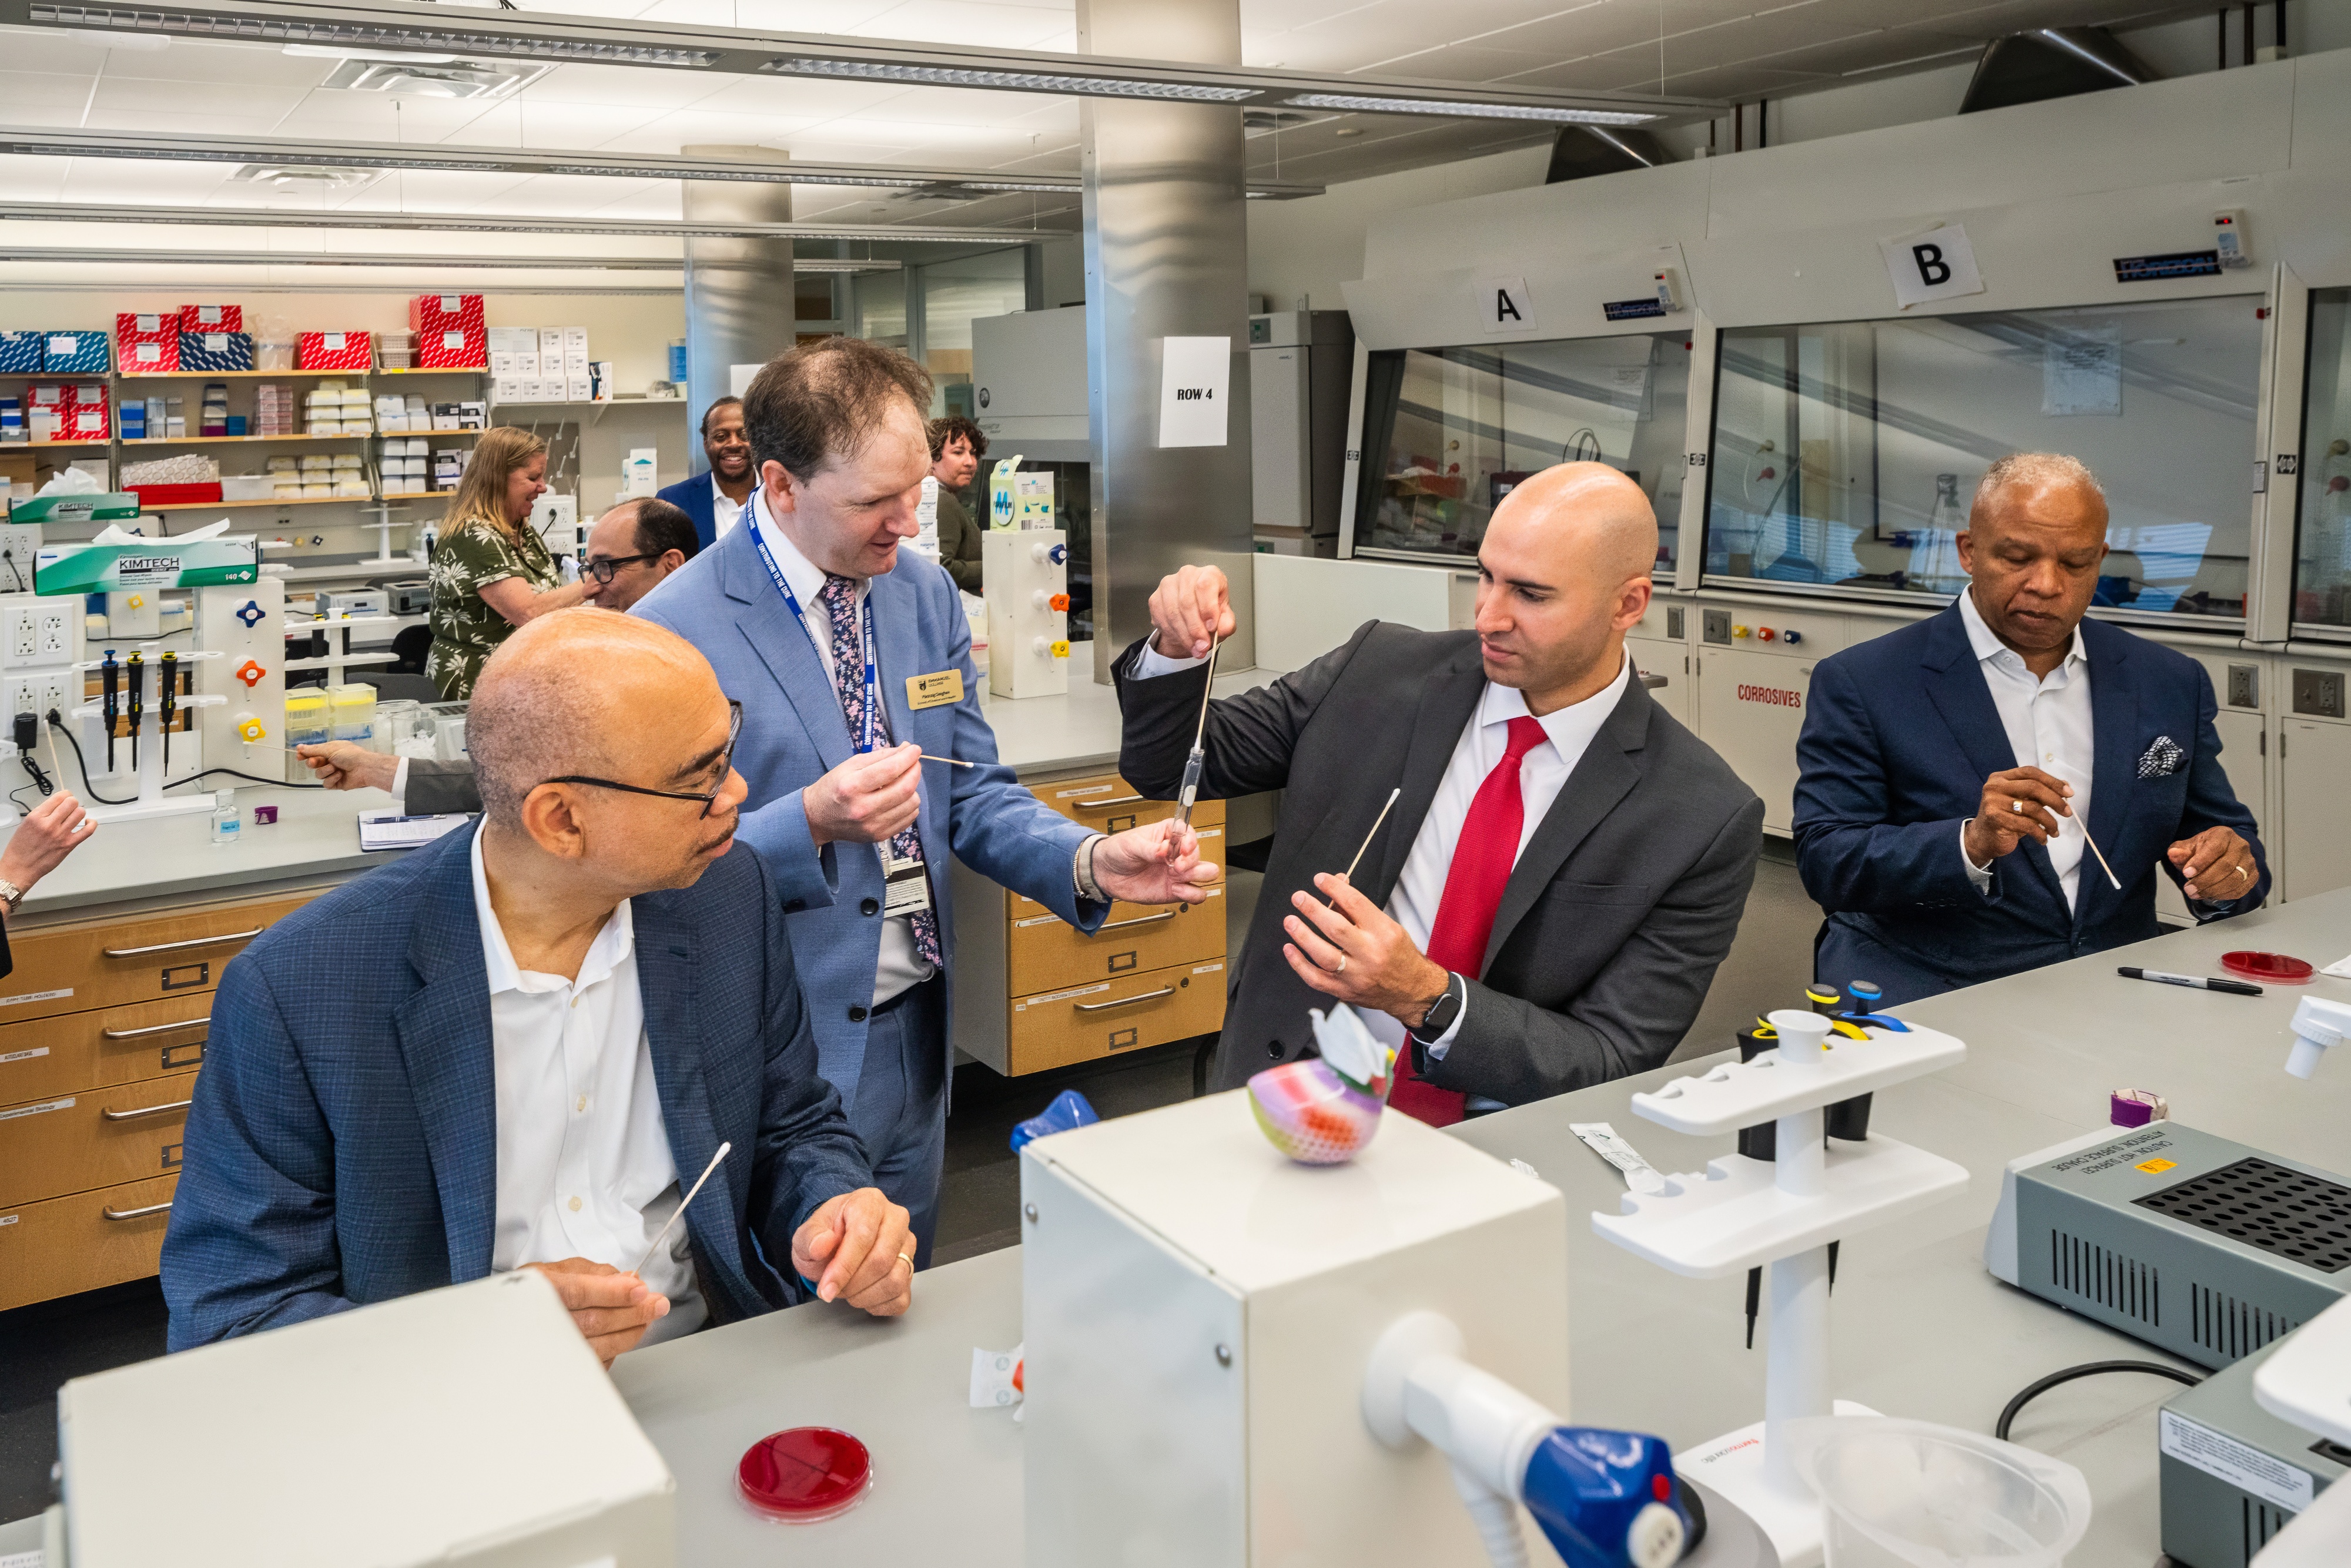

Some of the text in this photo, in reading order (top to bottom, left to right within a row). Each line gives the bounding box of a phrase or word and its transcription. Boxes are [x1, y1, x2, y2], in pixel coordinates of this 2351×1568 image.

[1913, 243, 1951, 286] B
[1498, 289, 1522, 322] A
[1177, 388, 1213, 400] ROW 4
[119, 557, 179, 569] KIMTECH
[1738, 684, 1801, 708] CORROSIVES
[864, 713, 873, 746] CONTRIBUTING
[2089, 1145, 2124, 1160] SURFACE
[2117, 1152, 2139, 1161] HOT
